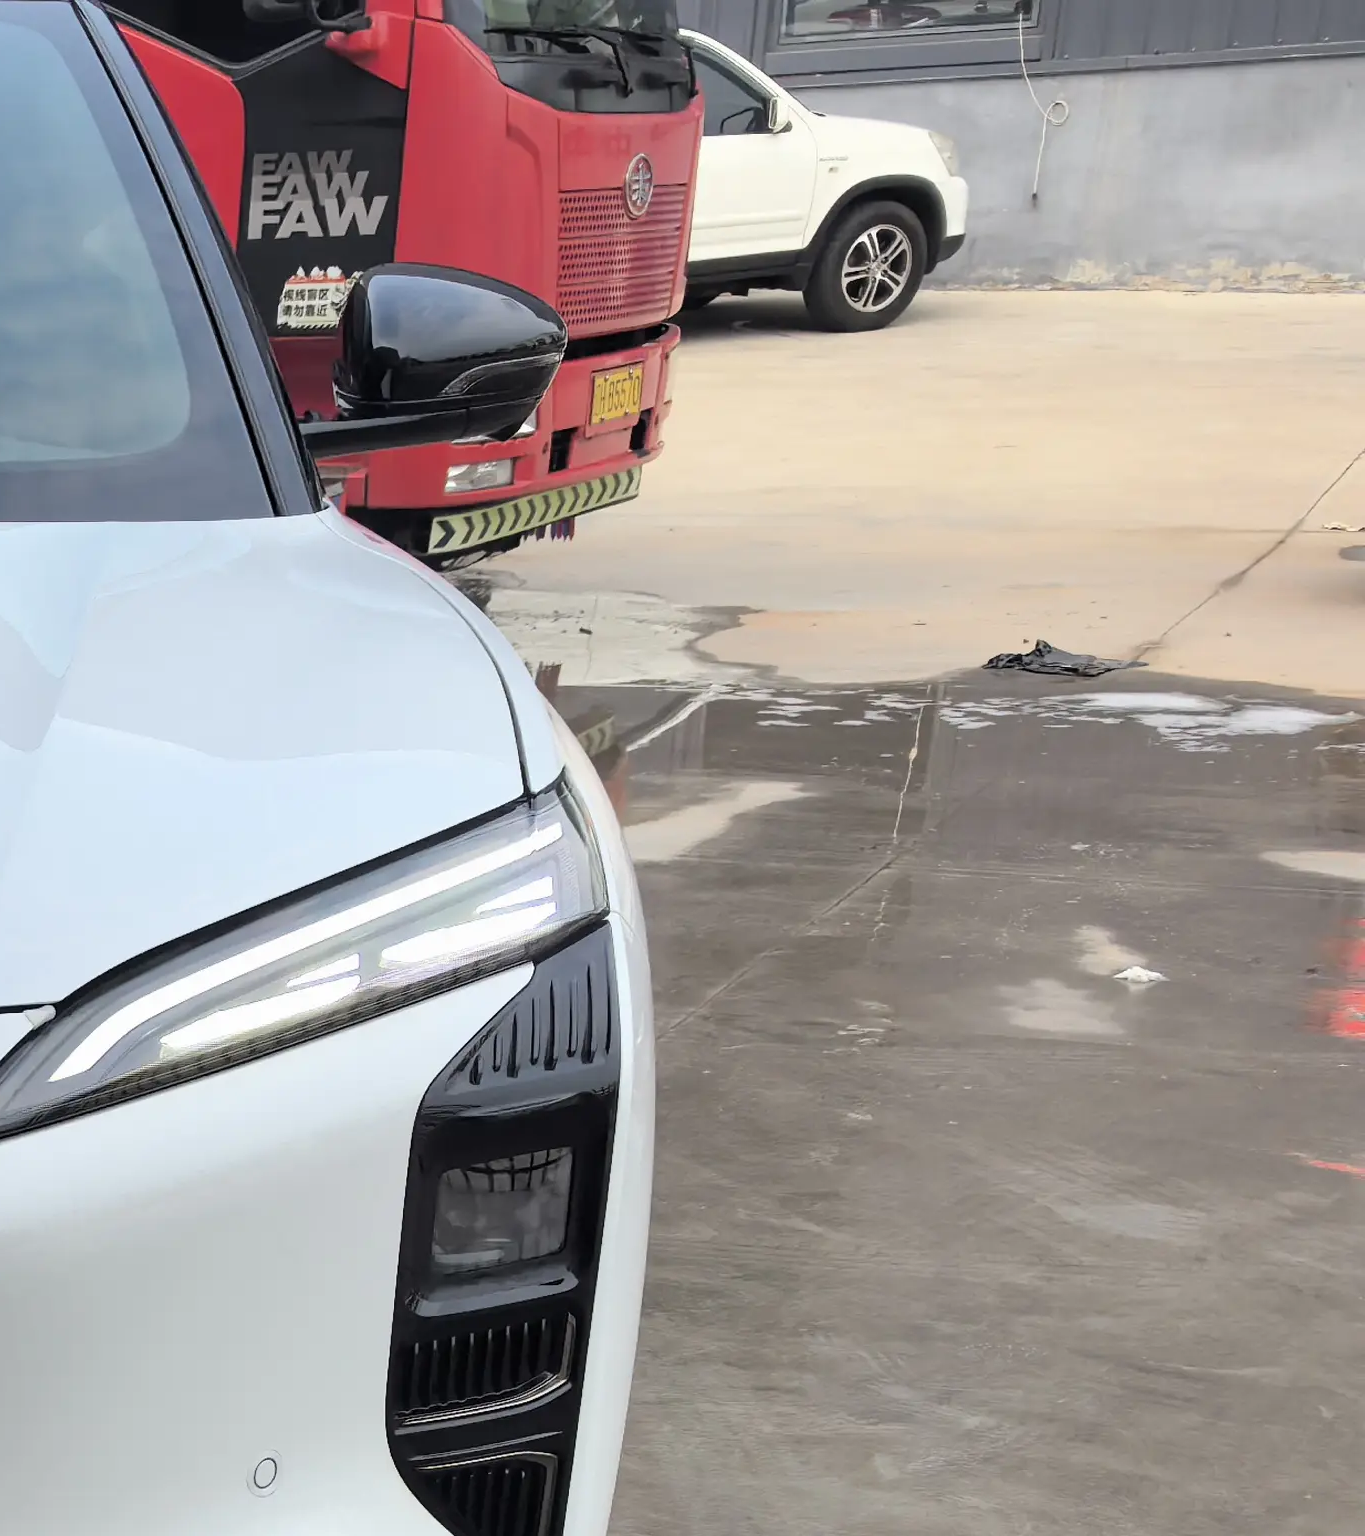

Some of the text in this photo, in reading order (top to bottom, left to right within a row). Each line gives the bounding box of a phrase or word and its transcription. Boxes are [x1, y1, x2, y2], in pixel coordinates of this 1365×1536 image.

[252, 149, 353, 178] FAW
[250, 170, 370, 206] FAW
[247, 195, 389, 240] FAW
